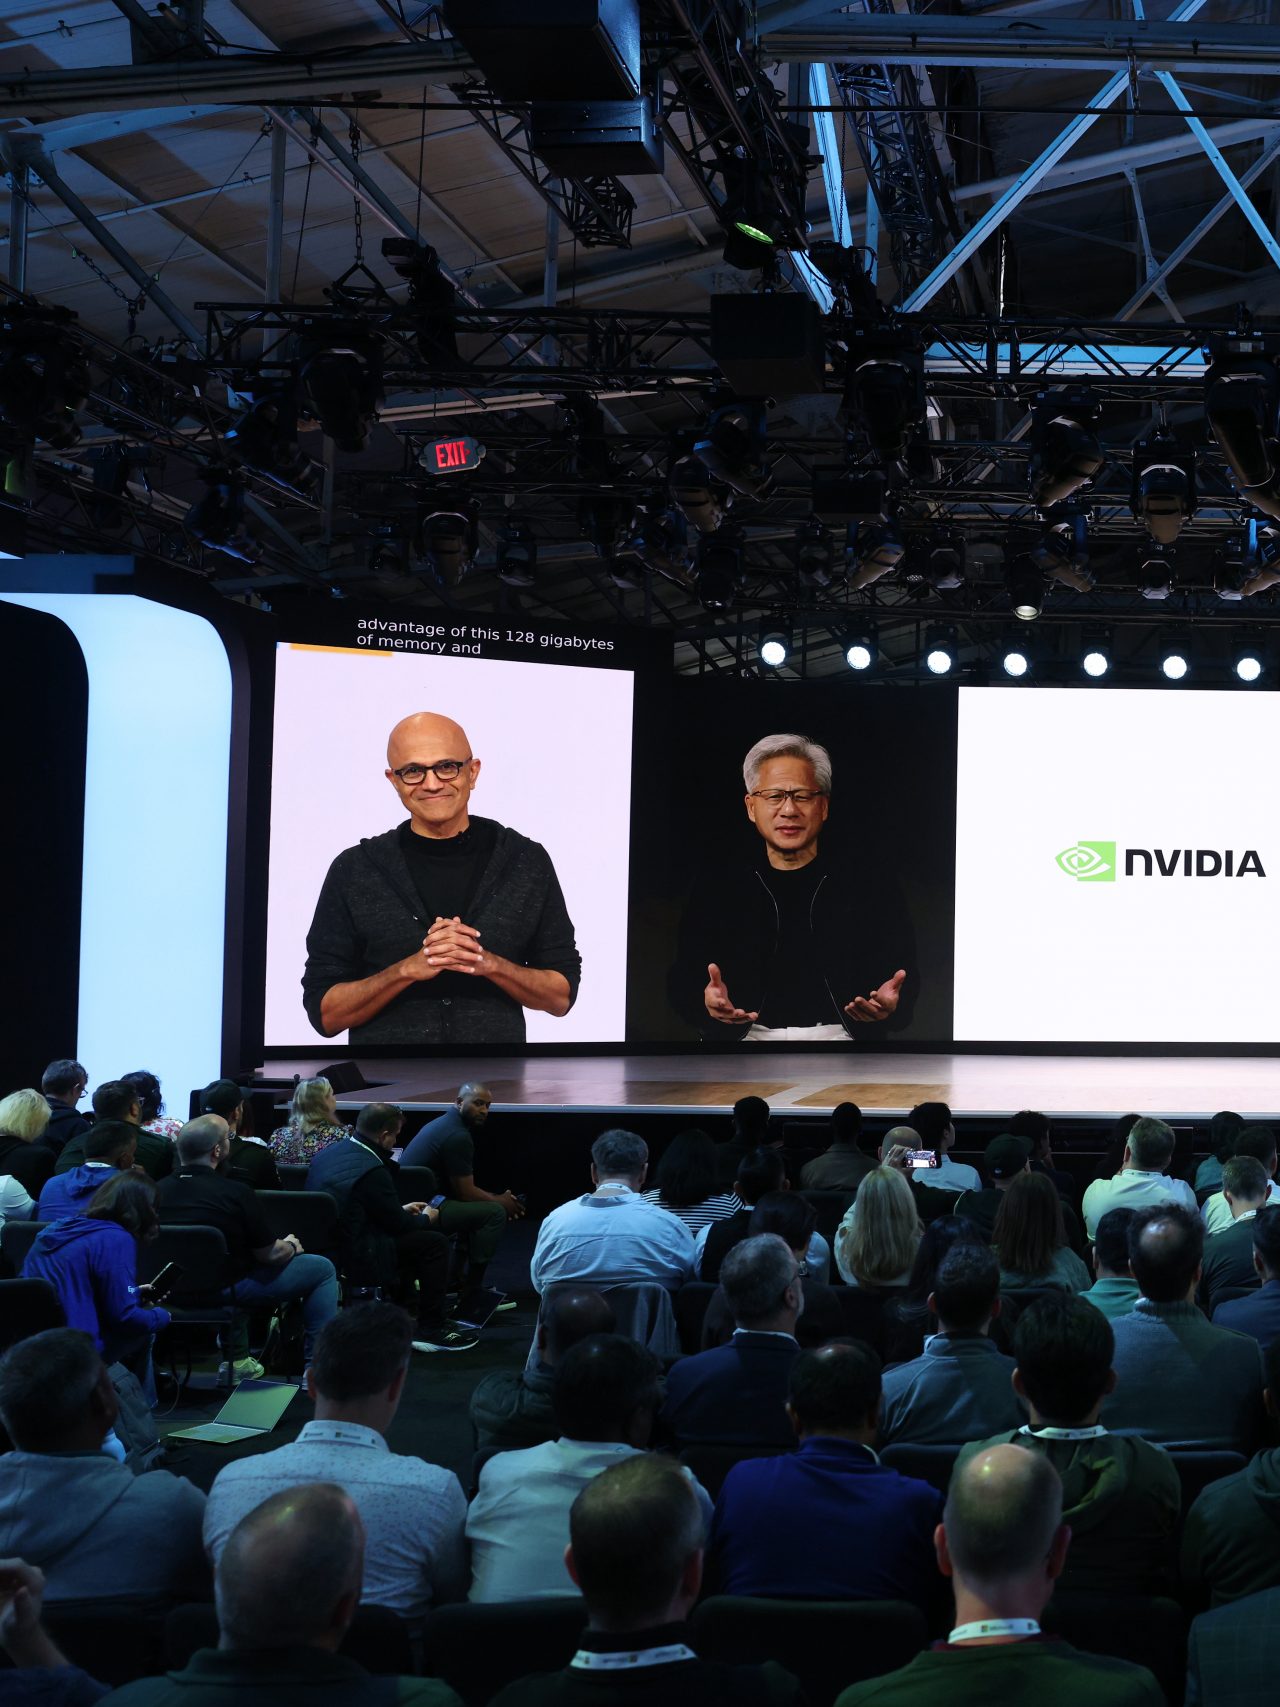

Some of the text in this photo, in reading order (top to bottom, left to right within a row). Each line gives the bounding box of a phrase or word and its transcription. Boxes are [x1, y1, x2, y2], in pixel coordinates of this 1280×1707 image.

[435, 440, 466, 468] EXIT
[356, 633, 481, 655] of memory and
[357, 618, 614, 651] advantage of this 128 gigabytes
[1125, 848, 1267, 878] NVIDIA
